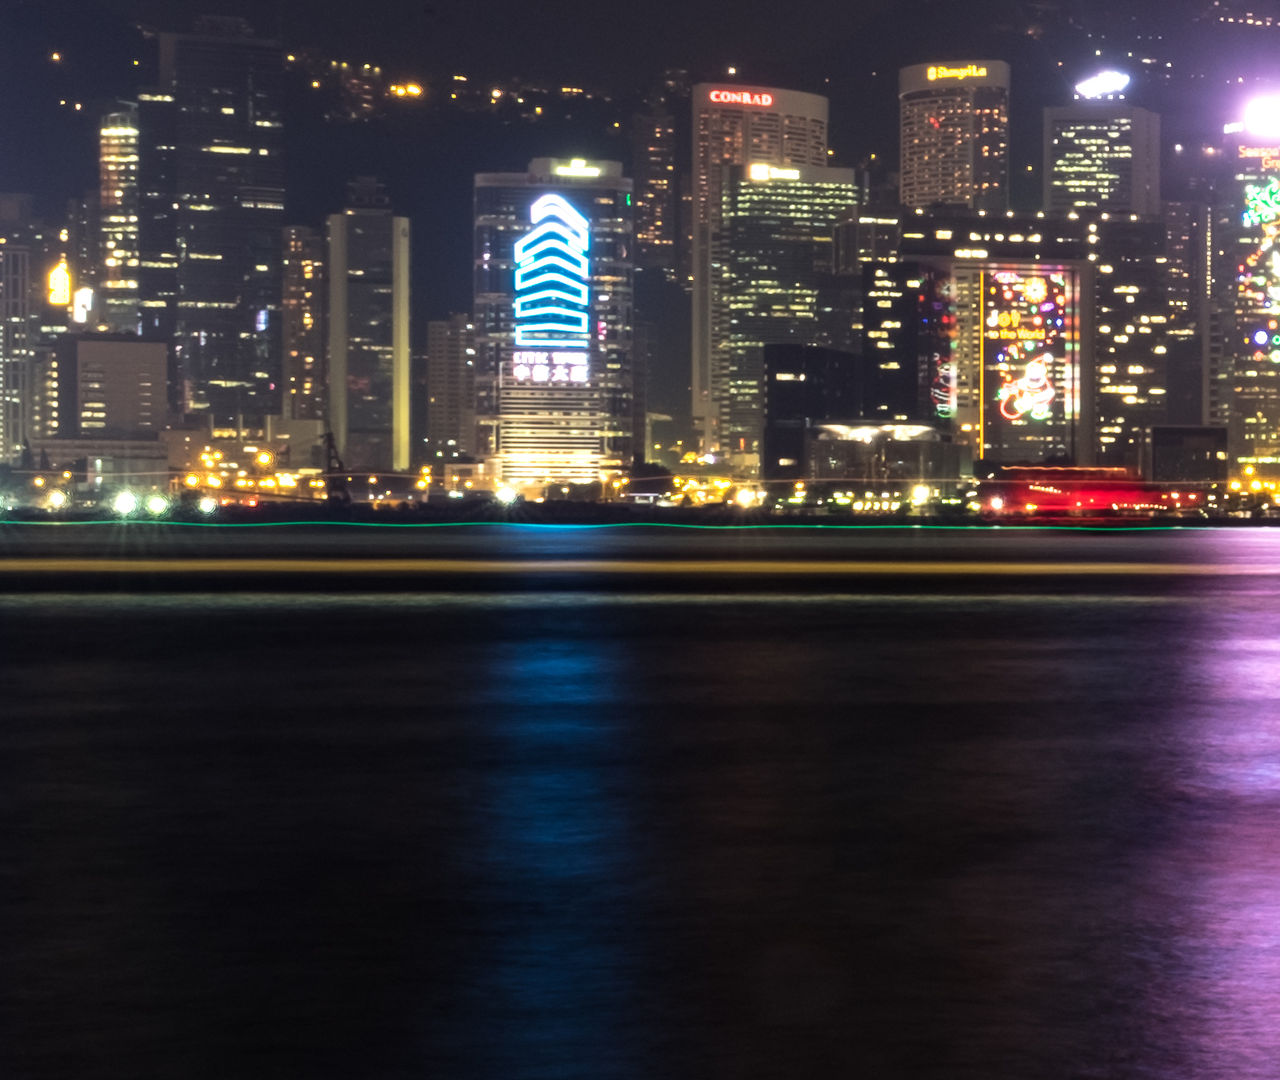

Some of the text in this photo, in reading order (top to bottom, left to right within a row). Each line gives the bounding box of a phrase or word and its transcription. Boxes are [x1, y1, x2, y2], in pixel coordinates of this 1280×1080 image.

[709, 90, 773, 107] CONRAD
[1000, 327, 1016, 339] the
[1016, 327, 1045, 339] World
